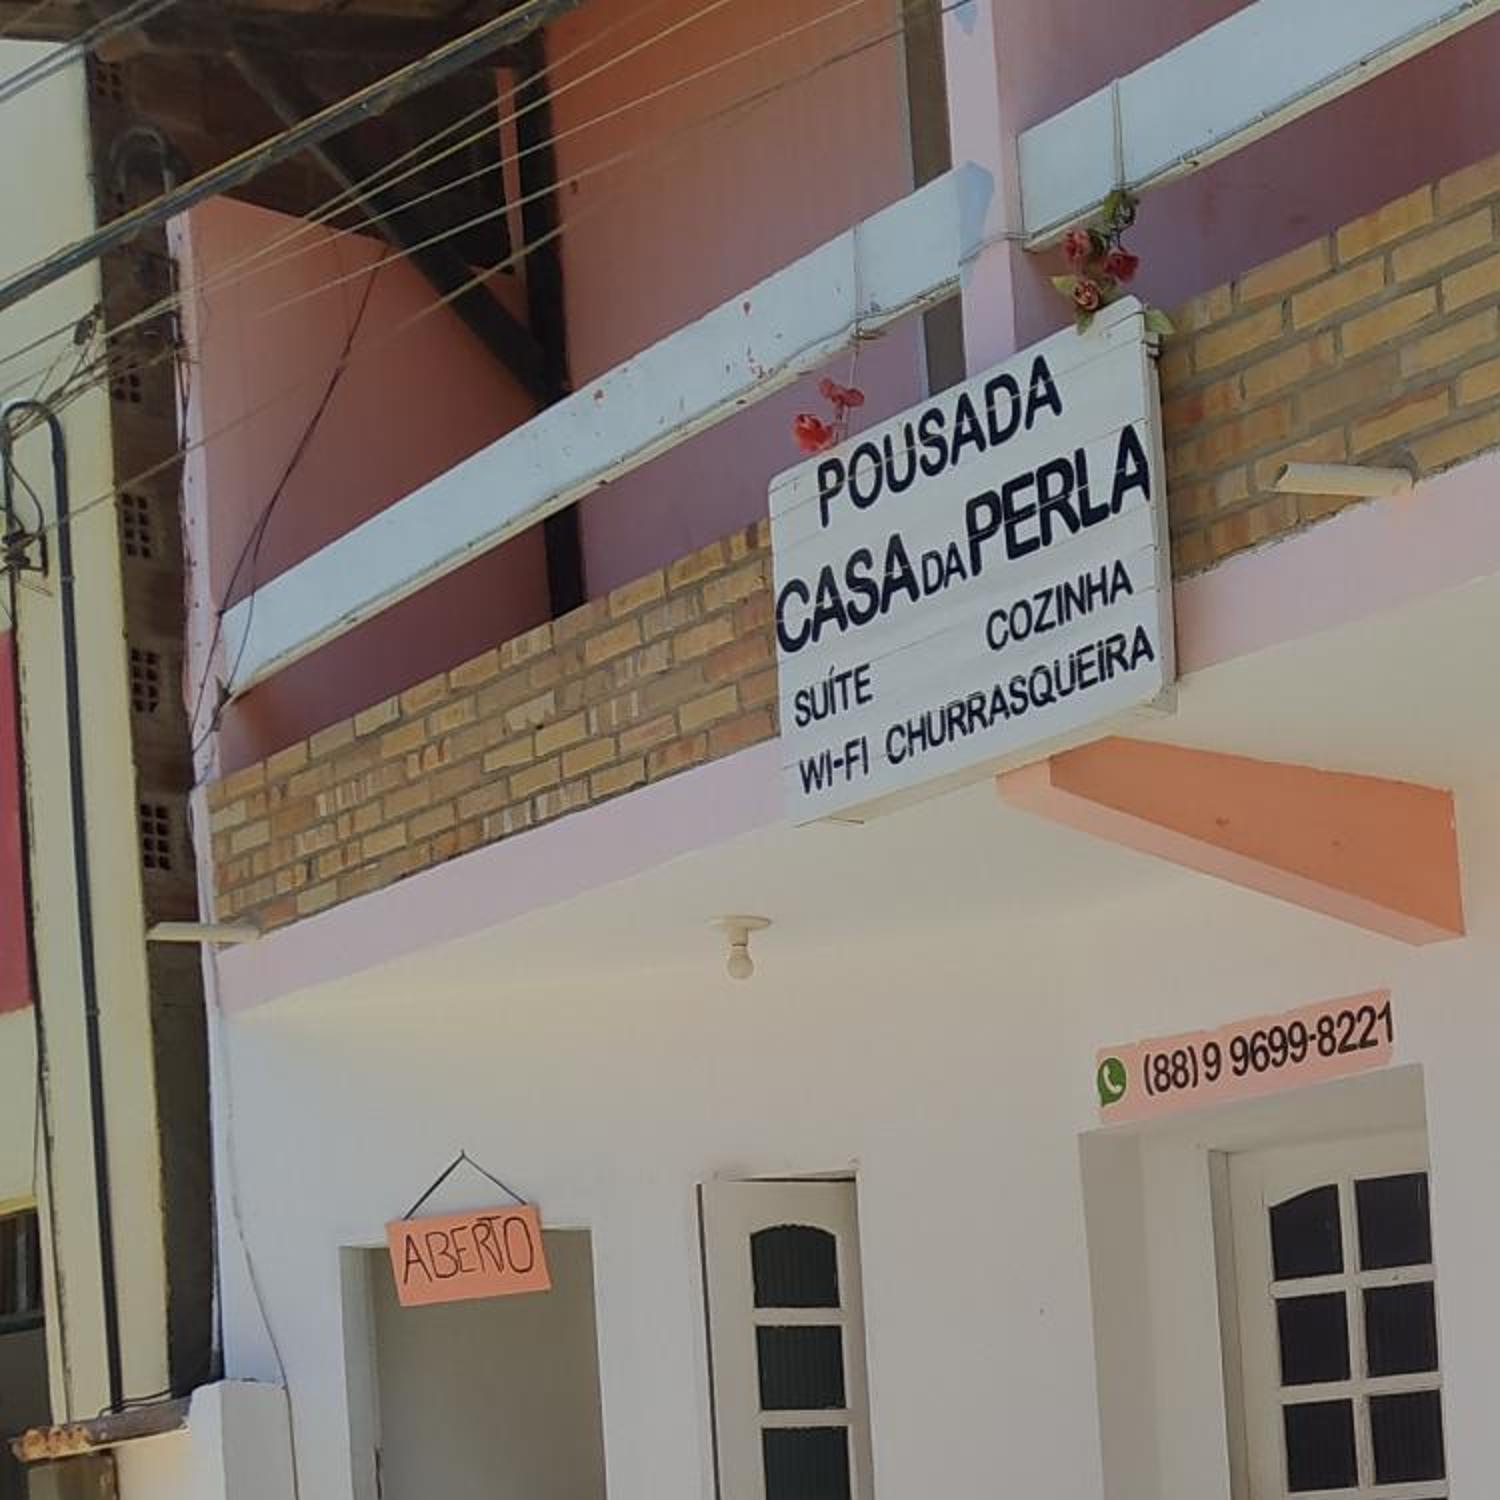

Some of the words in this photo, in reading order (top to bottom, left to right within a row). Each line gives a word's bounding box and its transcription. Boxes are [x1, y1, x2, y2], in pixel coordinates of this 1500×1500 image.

[817, 355, 1063, 528] POUSADA
[776, 533, 920, 653] CASA
[921, 542, 966, 597] DA
[966, 424, 1151, 577] PERLA
[986, 559, 1134, 652] COZINHA
[794, 663, 873, 729] SUÍTE
[800, 736, 869, 795] WI-FI
[885, 625, 1155, 766] CHURRASQUEIRA
[1229, 1000, 1394, 1077] 9699-8221
[403, 1215, 535, 1285] ABERTO
